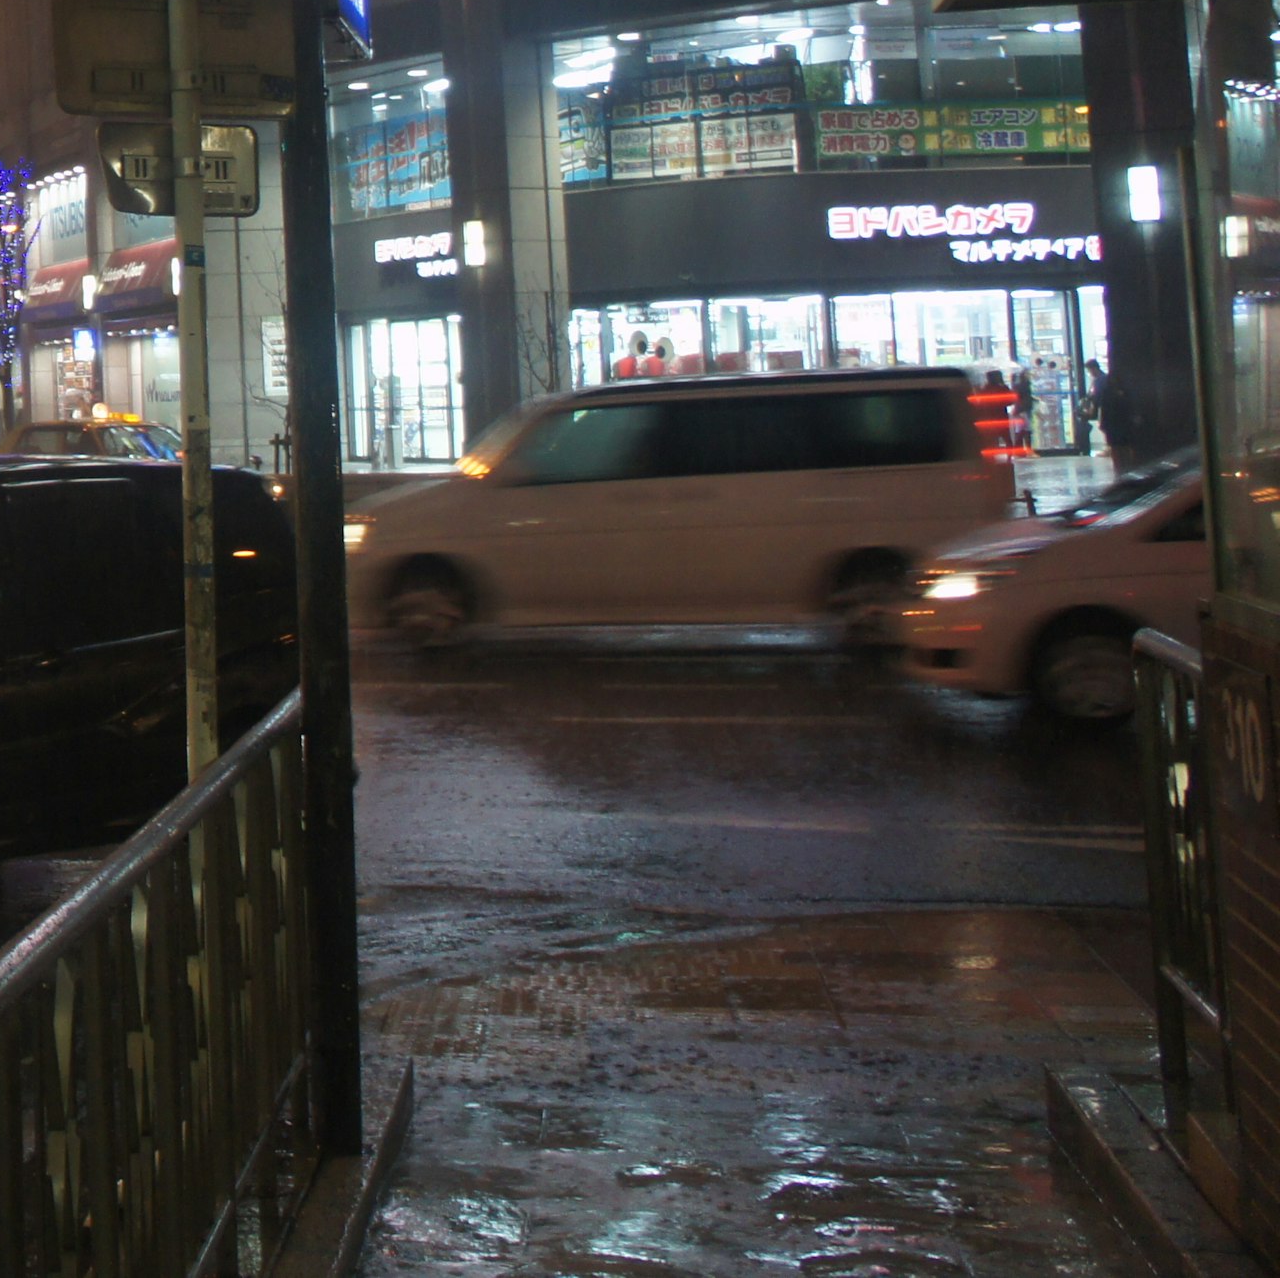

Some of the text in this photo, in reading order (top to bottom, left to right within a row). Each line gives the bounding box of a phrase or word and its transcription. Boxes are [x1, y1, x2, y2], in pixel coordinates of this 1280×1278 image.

[971, 108, 1037, 126] エアコン
[820, 132, 889, 155] 消費電力
[976, 130, 1028, 151] 冷蔵庫
[829, 203, 1034, 239] ヨドバシカメラ
[949, 238, 1085, 263] マルチメディア
